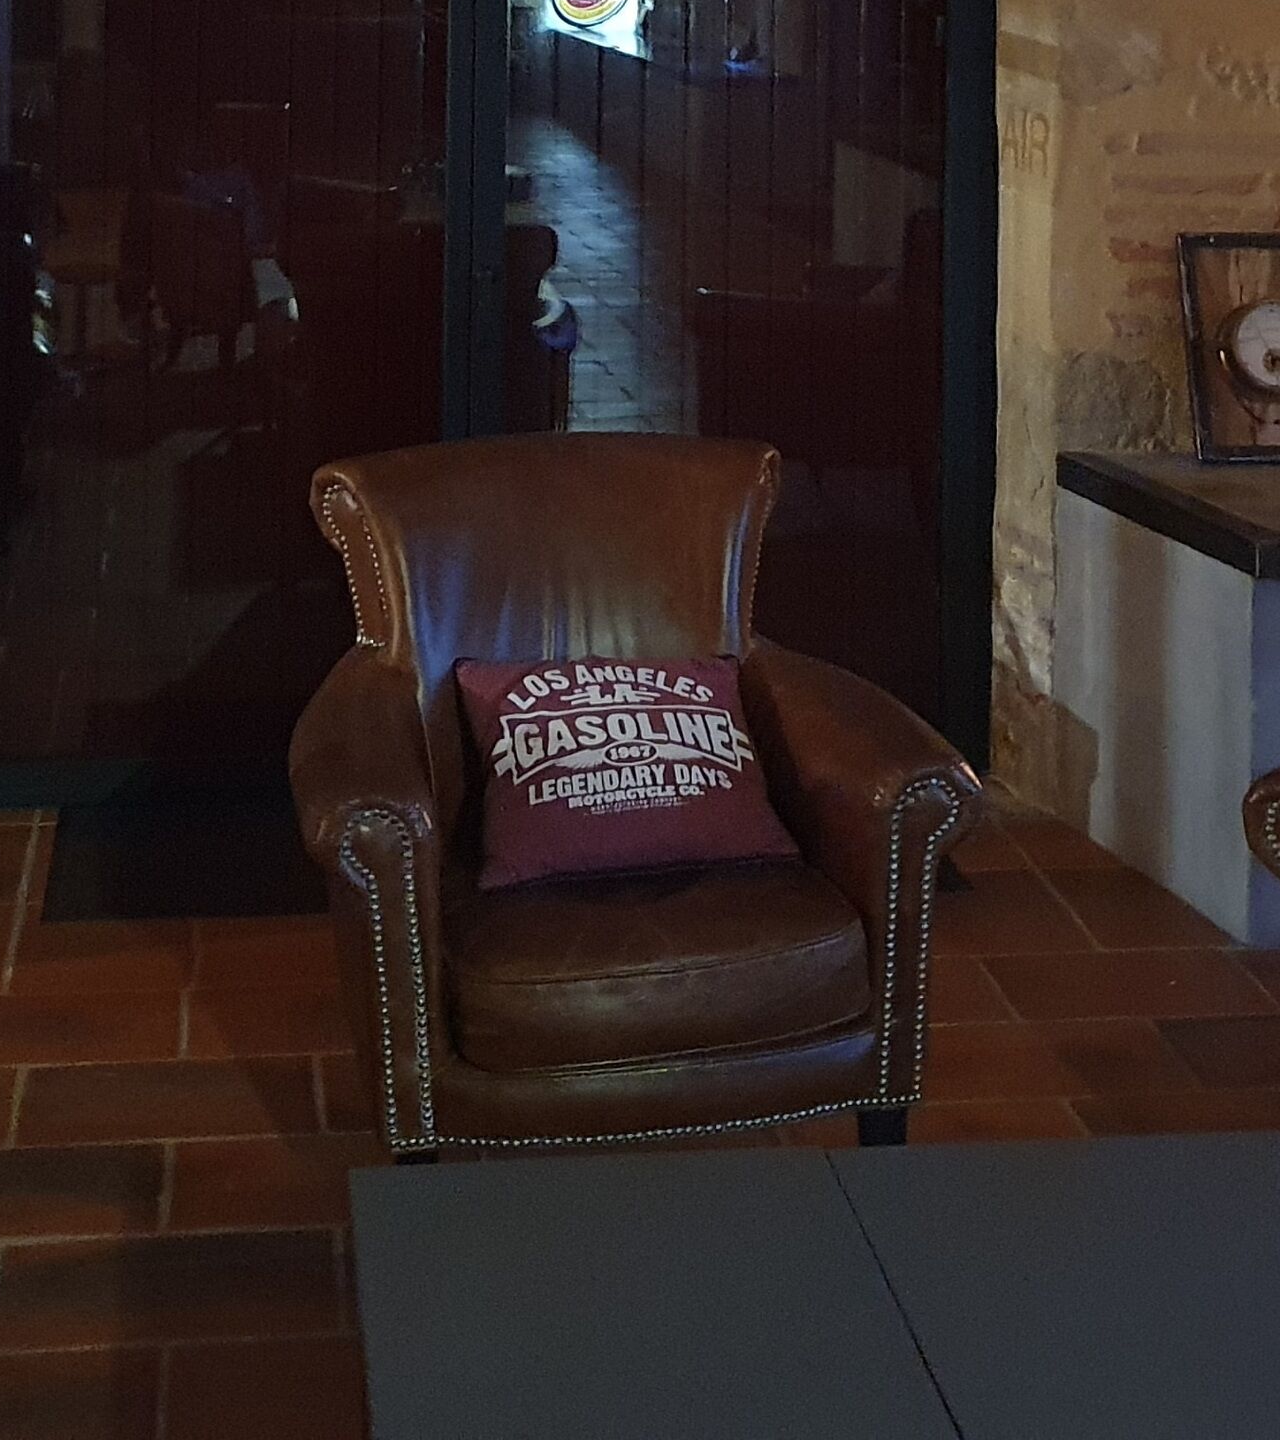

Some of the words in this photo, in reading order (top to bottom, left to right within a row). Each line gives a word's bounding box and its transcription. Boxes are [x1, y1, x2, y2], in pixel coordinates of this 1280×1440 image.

[506, 669, 570, 710] LOS
[575, 664, 714, 702] ANGELES
[513, 712, 737, 768] GASOLINE
[528, 764, 666, 806] LEGENDARY
[674, 763, 733, 790] DAYS
[569, 785, 676, 809] MOTORCYCLE
